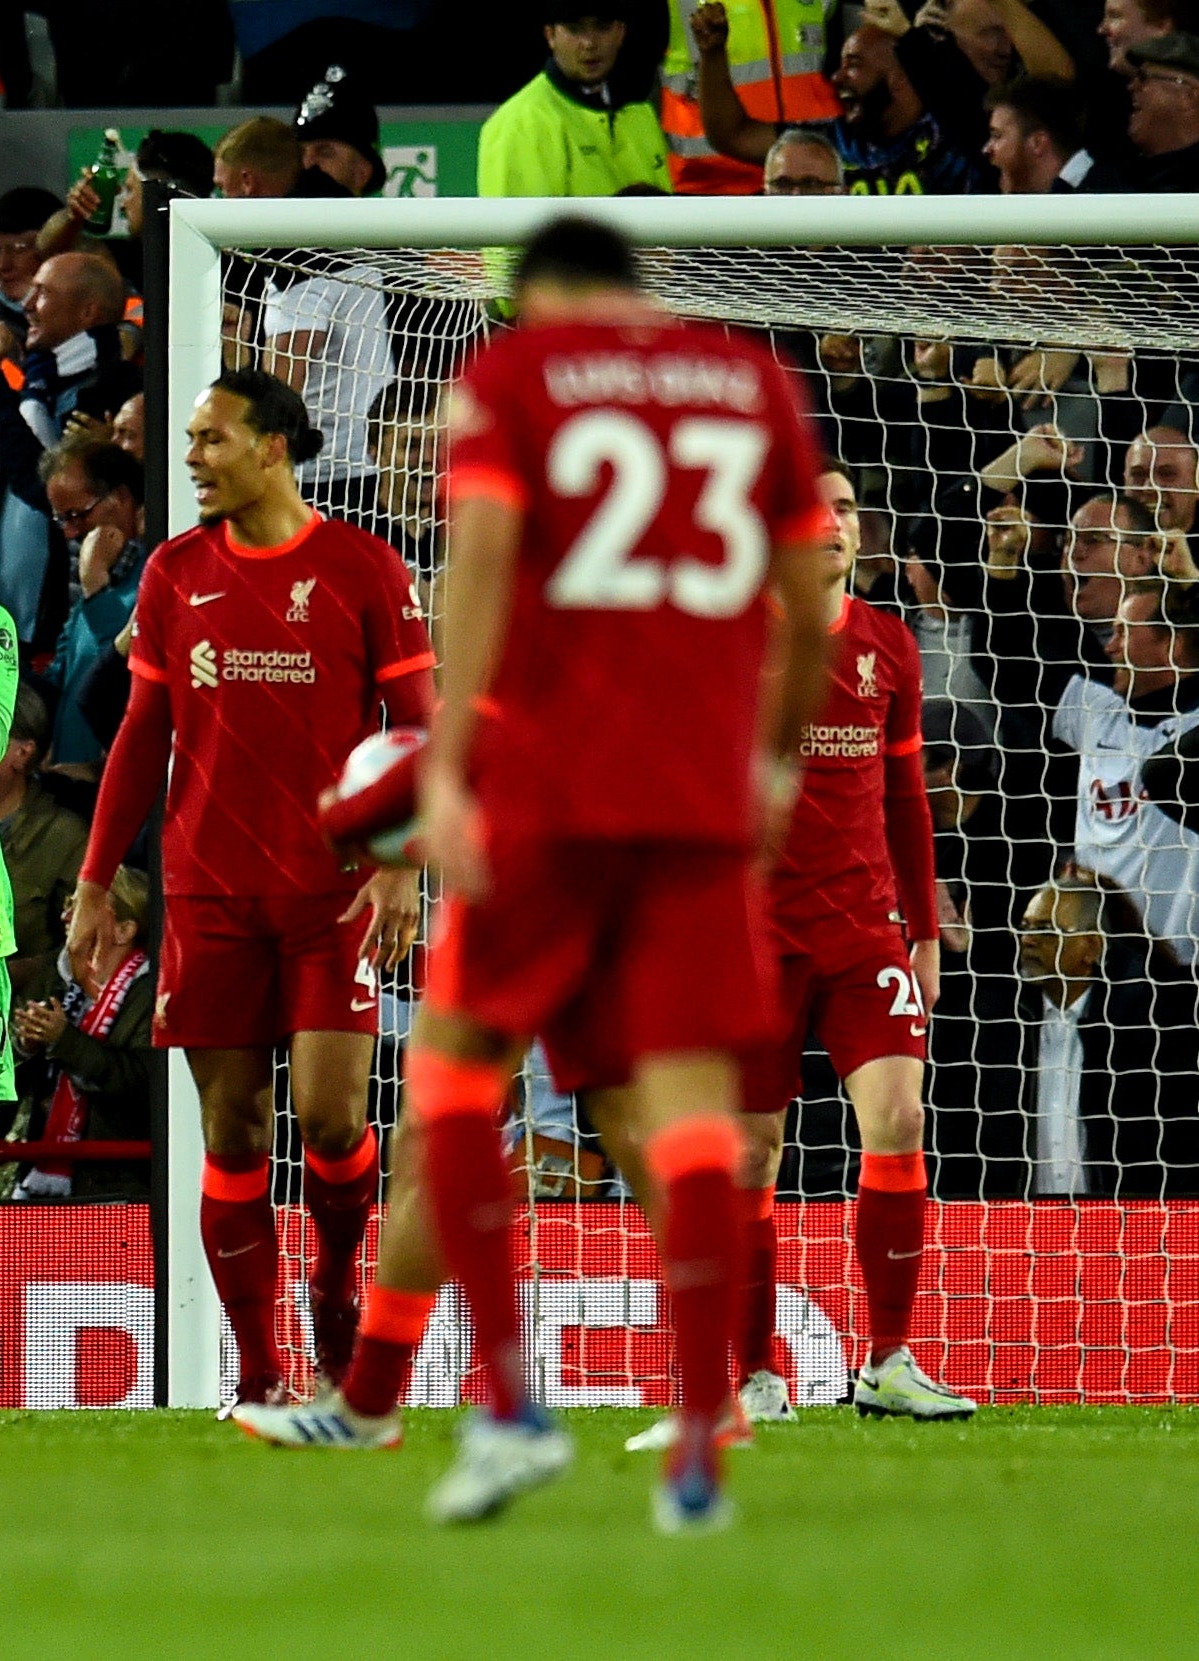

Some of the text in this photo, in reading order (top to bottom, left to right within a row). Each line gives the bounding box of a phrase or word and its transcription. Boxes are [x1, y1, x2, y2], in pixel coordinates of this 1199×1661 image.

[545, 405, 773, 620] 23
[222, 666, 316, 684] chartered
[223, 649, 311, 668] standard
[354, 956, 376, 998] 4
[876, 965, 924, 1018] 2
